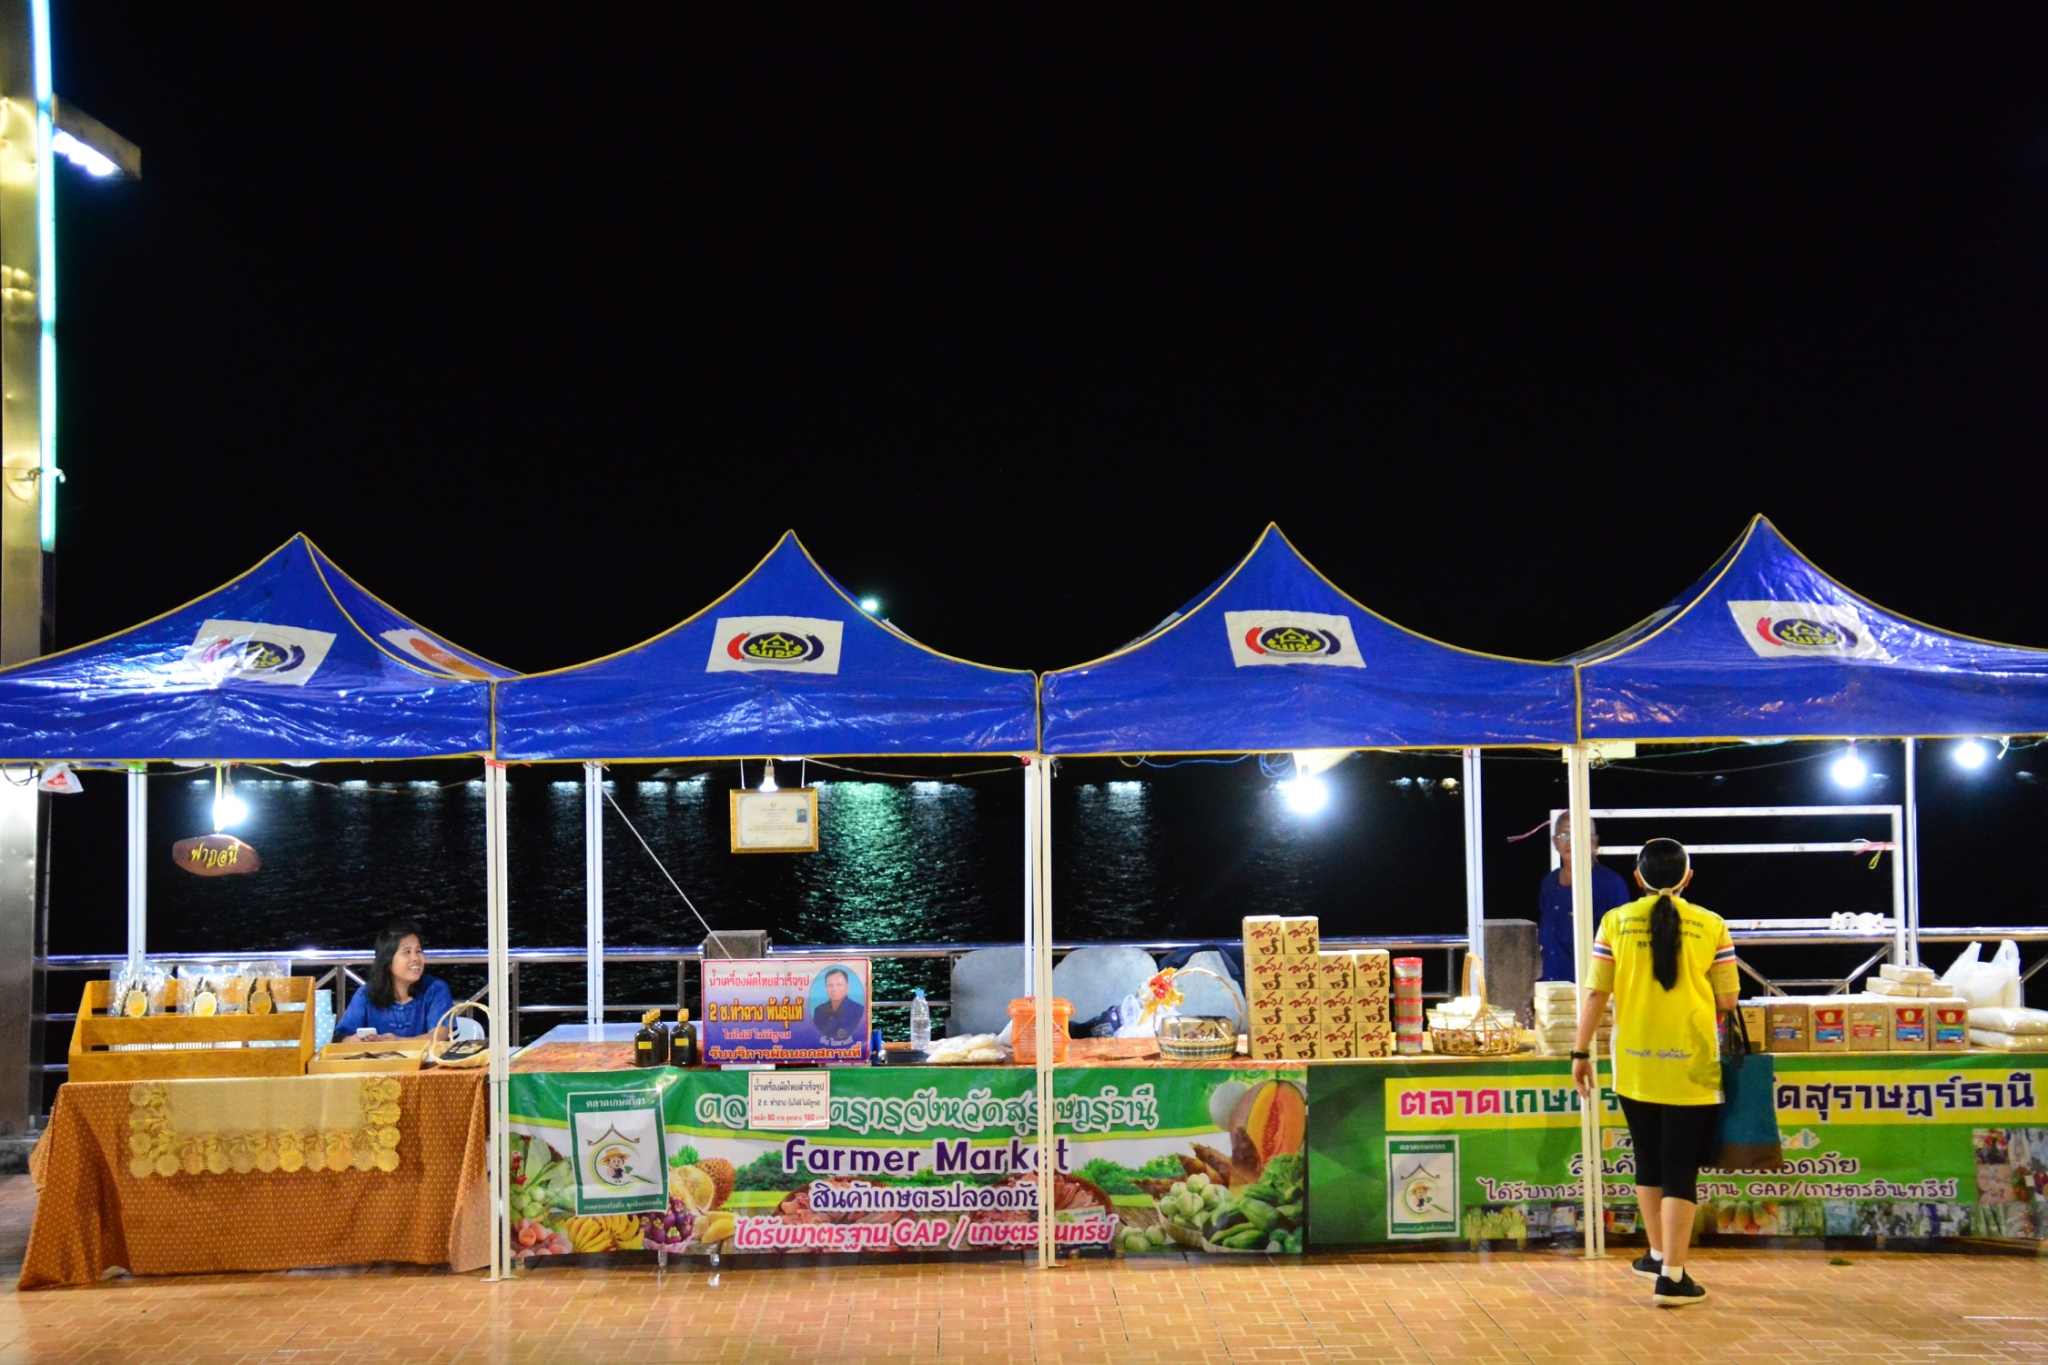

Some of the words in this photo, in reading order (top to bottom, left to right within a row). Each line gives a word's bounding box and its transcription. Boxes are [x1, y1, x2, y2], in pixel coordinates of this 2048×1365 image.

[709, 969, 809, 991] น้ำเครื่องผัดไทยสำเร็จรูป
[709, 1002, 718, 1022] 2
[766, 996, 804, 1030] พันธุ์แท้
[709, 1041, 861, 1059] รับบริการผัดนอกสถานที่
[754, 1078, 825, 1094] น้ำเครื่องผัดไทยสำเร็จรูป
[786, 1139, 920, 1172] Farmer
[737, 1219, 889, 1250] ได้รับมาตรฐาน
[896, 1222, 948, 1243] GAP
